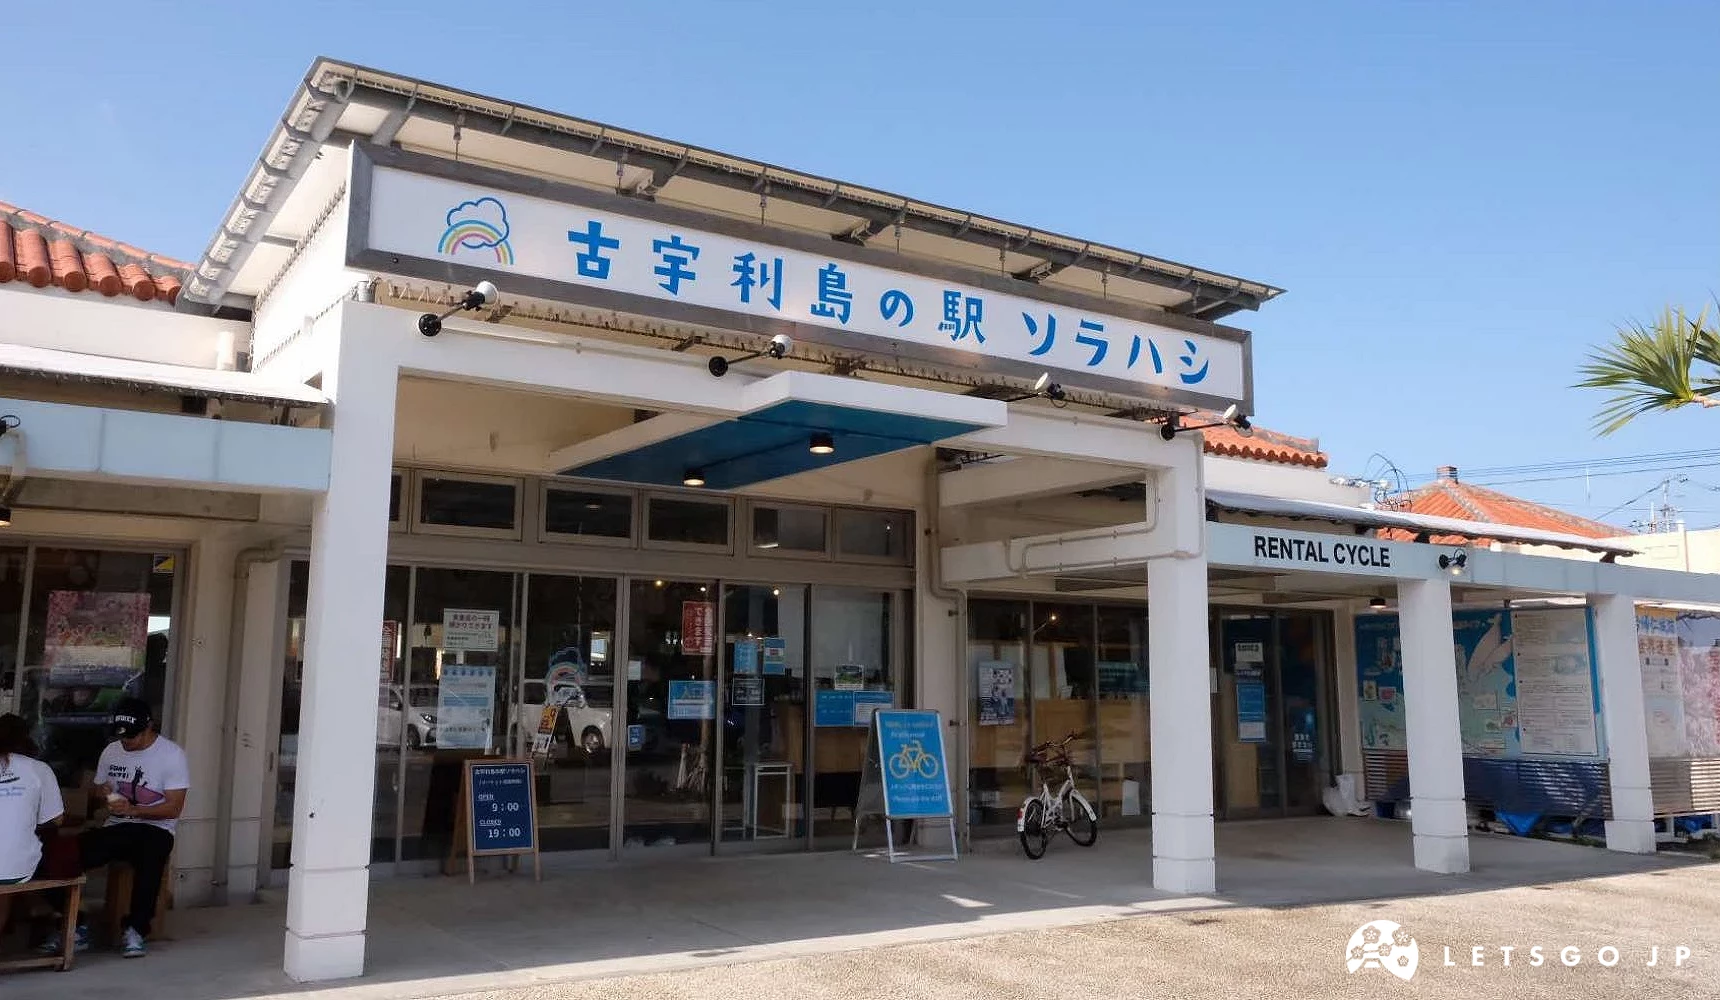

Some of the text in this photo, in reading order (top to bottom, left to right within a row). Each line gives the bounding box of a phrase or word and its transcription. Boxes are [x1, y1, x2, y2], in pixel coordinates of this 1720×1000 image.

[567, 220, 1209, 384] 古宇利島の駅 ソラハシ
[1254, 535, 1391, 568] RENTAL CYCLE
